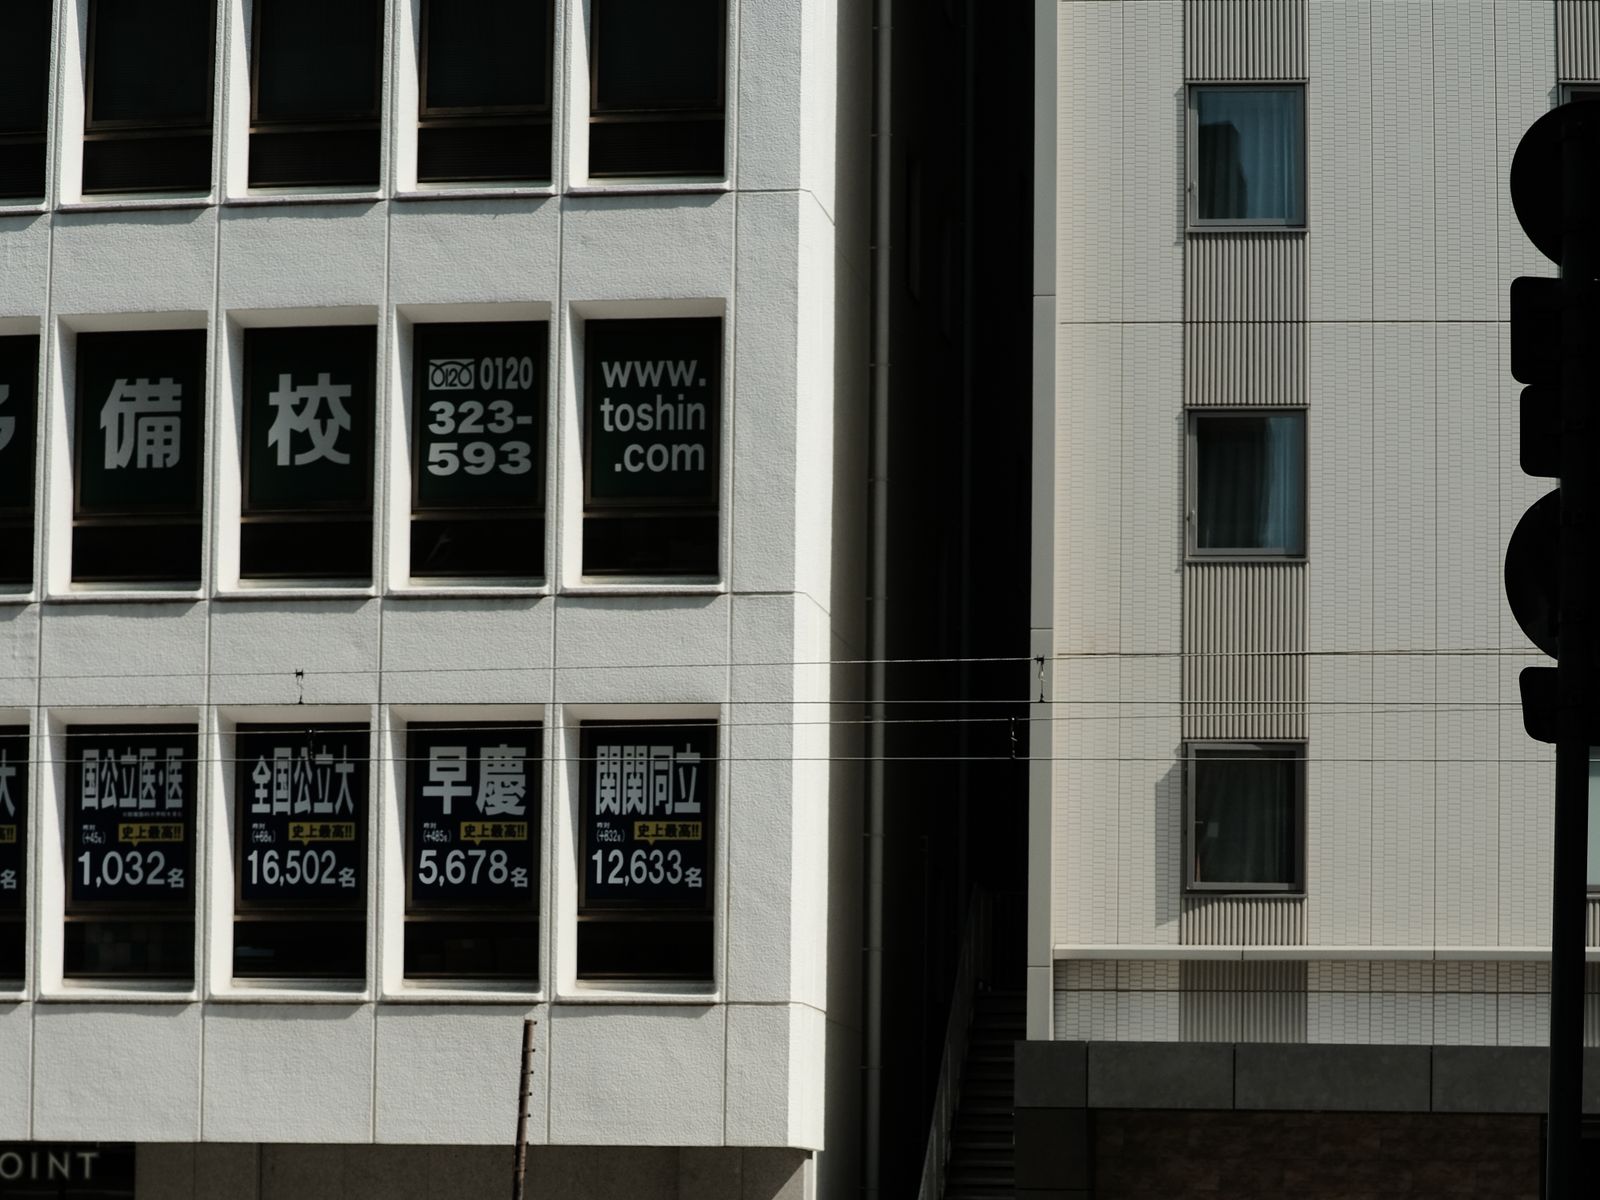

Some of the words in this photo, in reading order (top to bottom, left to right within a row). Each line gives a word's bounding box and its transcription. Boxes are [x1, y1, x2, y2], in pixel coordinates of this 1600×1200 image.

[480, 356, 533, 390] 0120
[601, 360, 706, 388] www.
[428, 400, 533, 435] 323-
[600, 394, 705, 432] toshin
[427, 441, 532, 476] 593
[614, 443, 705, 472] .com
[251, 744, 354, 816] 全国公立大
[422, 743, 527, 816] 早慶
[595, 742, 701, 816] 関関同立
[0, 1151, 100, 1180] OINT
